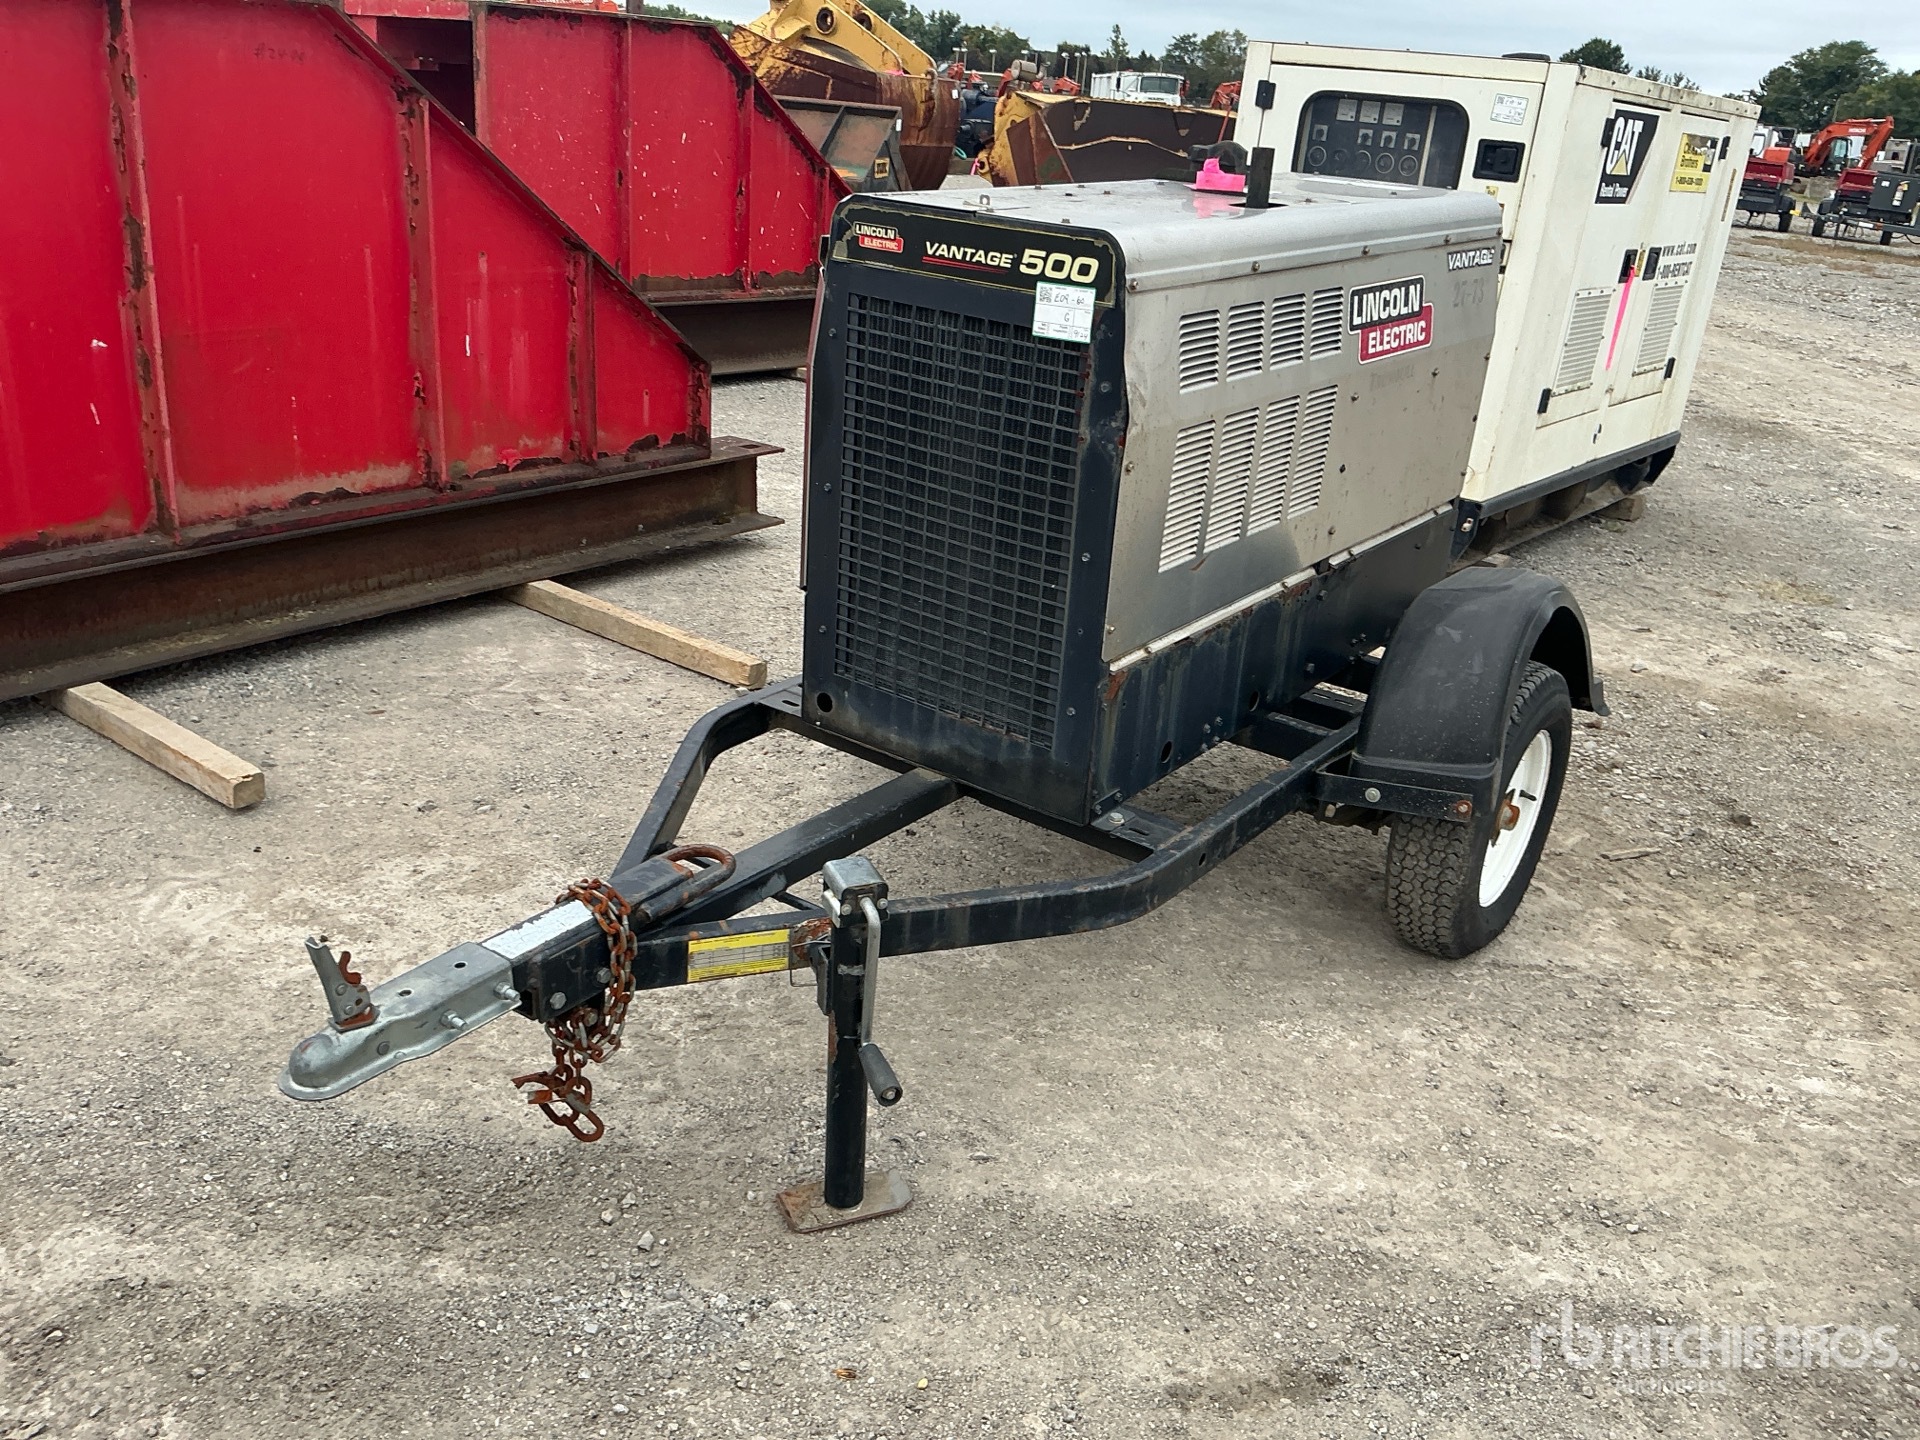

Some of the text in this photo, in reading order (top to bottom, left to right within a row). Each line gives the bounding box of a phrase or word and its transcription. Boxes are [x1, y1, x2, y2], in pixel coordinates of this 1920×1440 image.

[1605, 117, 1644, 175] CAT
[855, 223, 896, 240] LINCOLN
[863, 238, 899, 251] ELECTRIC
[925, 241, 1100, 284] VANTAGE 500
[1447, 246, 1494, 270] VANTAGE
[1352, 283, 1422, 326] LINCOLN
[1368, 319, 1428, 355] ELECTRIC
